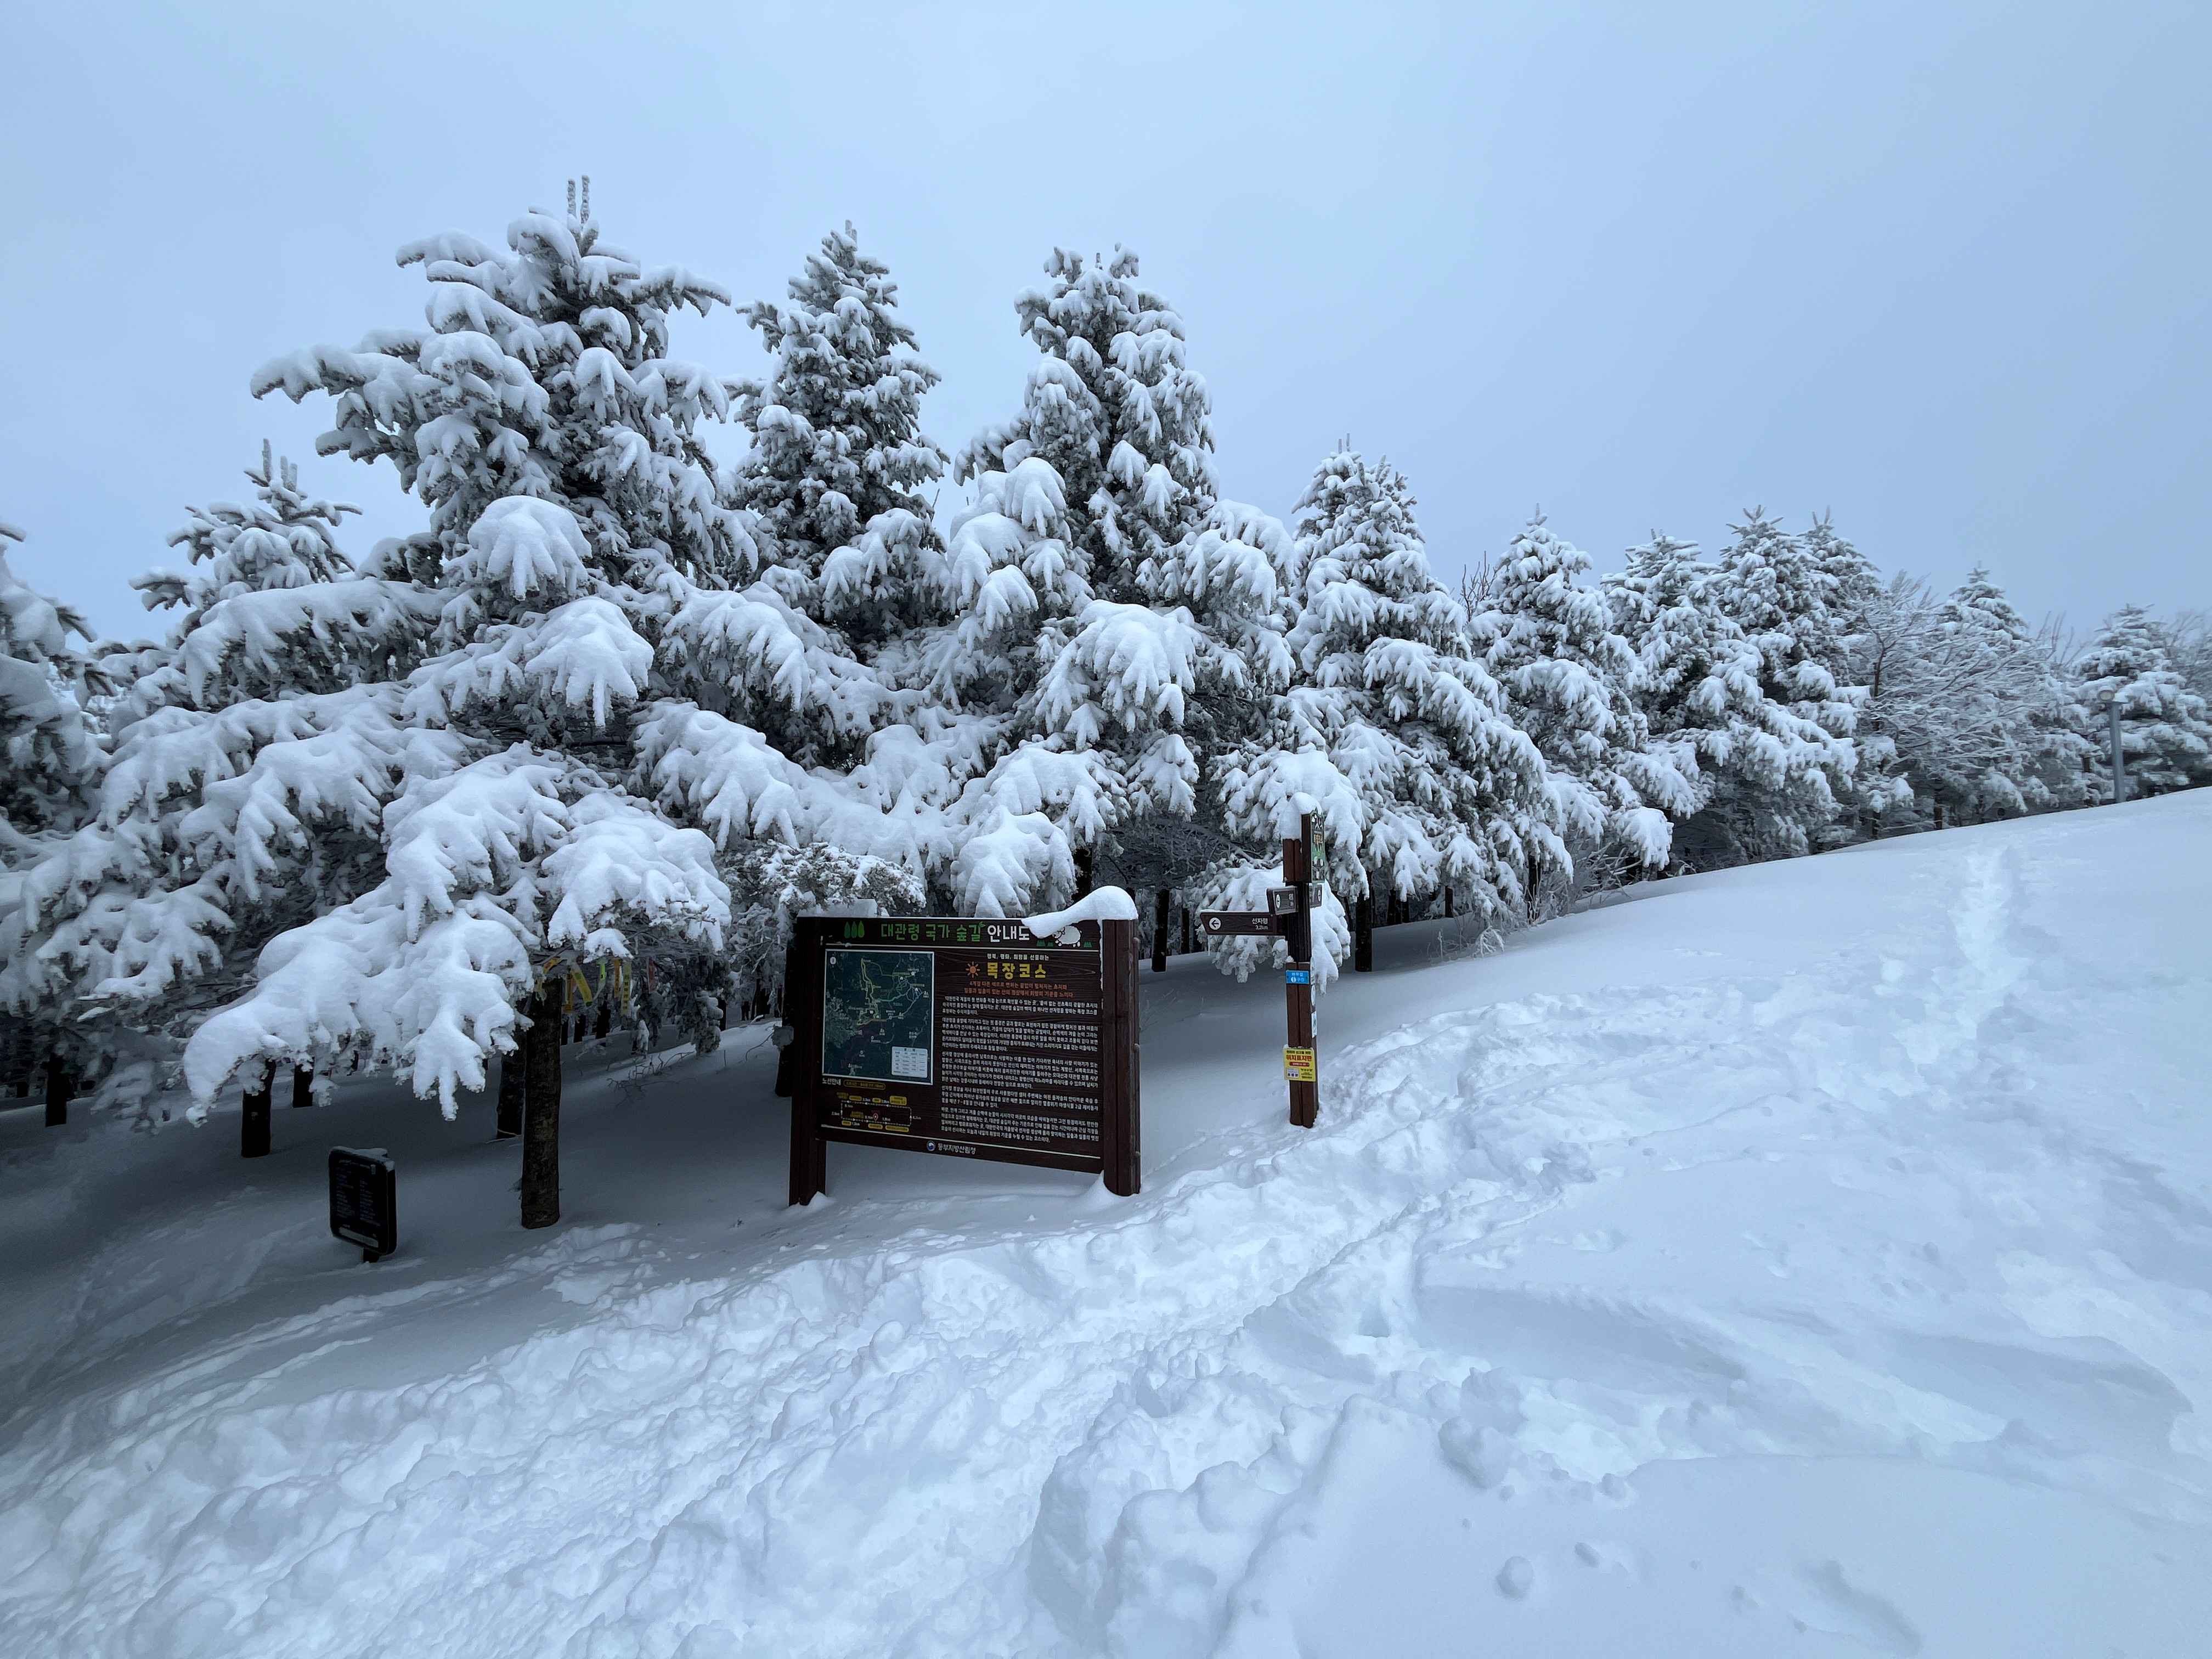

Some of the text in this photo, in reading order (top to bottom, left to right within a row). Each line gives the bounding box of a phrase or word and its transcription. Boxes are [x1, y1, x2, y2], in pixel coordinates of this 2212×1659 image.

[880, 923, 1030, 943] 대관령 국가 숲길 안내도
[986, 961, 1047, 980] 목장코스
[822, 1077, 842, 1086] 노선안내
[938, 1143, 976, 1155] 동부지방산림청
